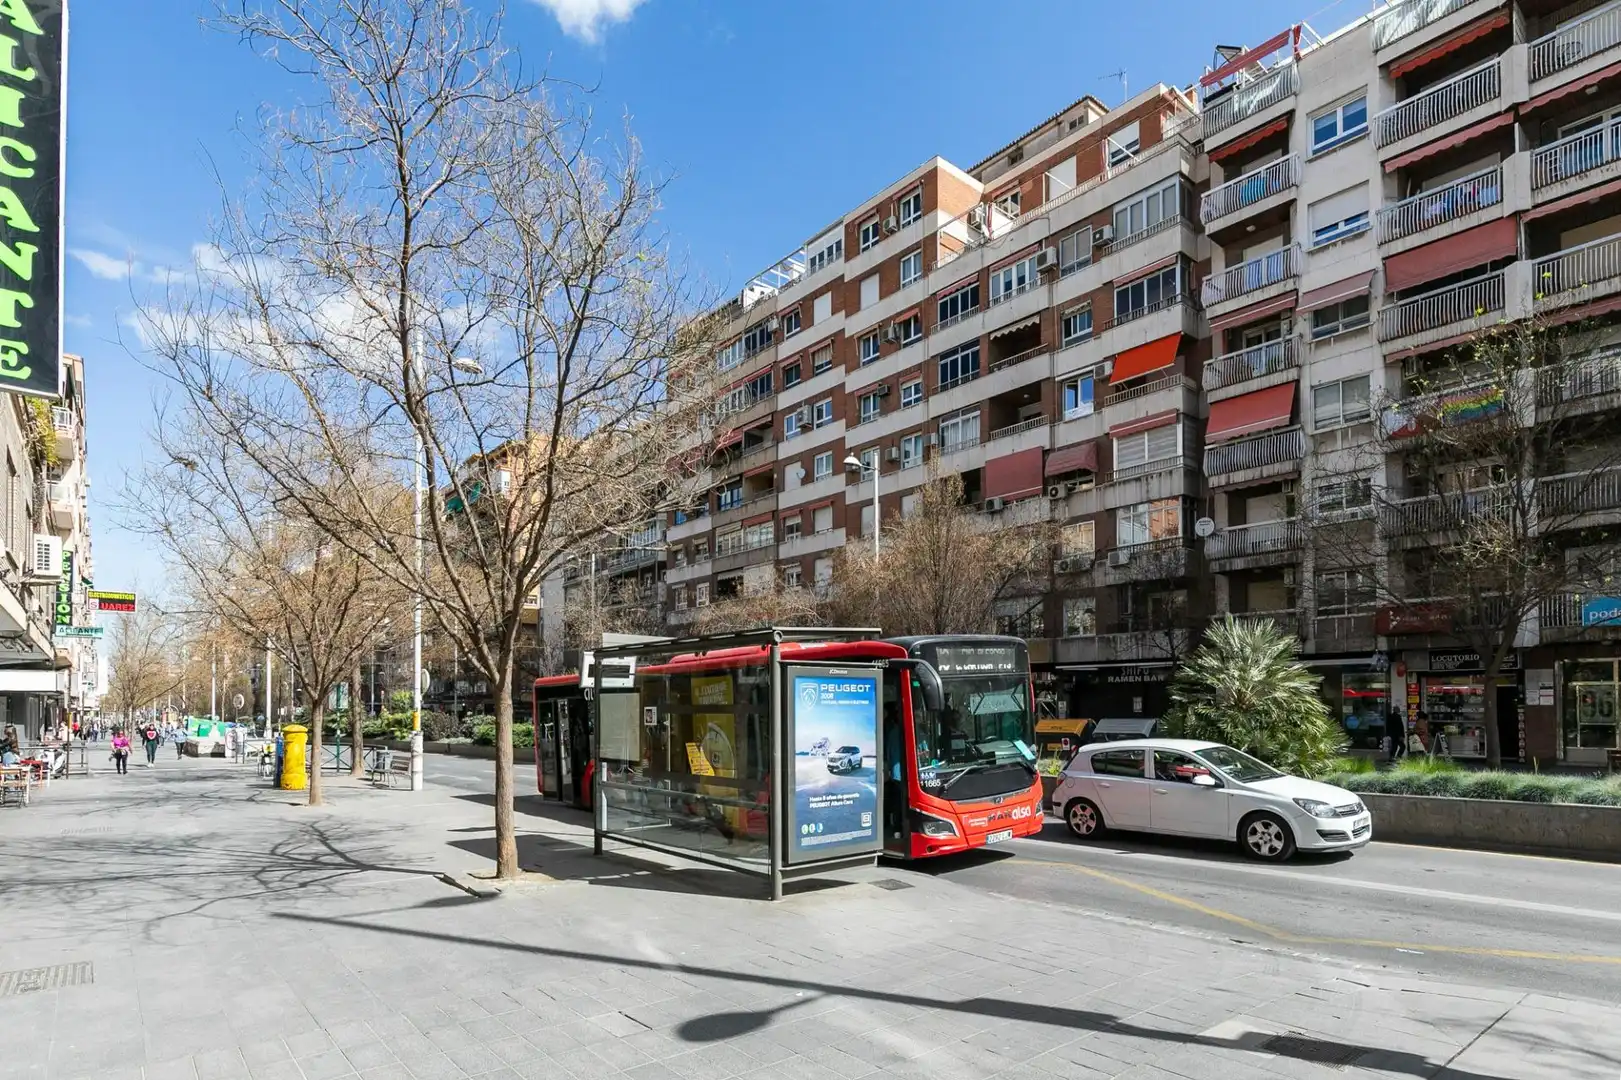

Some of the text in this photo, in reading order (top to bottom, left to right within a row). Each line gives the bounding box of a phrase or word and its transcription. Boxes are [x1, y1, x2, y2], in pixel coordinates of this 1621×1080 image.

[57, 551, 71, 624] PENSION
[1431, 654, 1480, 662] LOCUTORIO
[1107, 674, 1164, 683] RAMEN BAR
[820, 684, 871, 692] PEUGEOT
[920, 779, 941, 787] 11665
[1012, 806, 1031, 819] alsa
